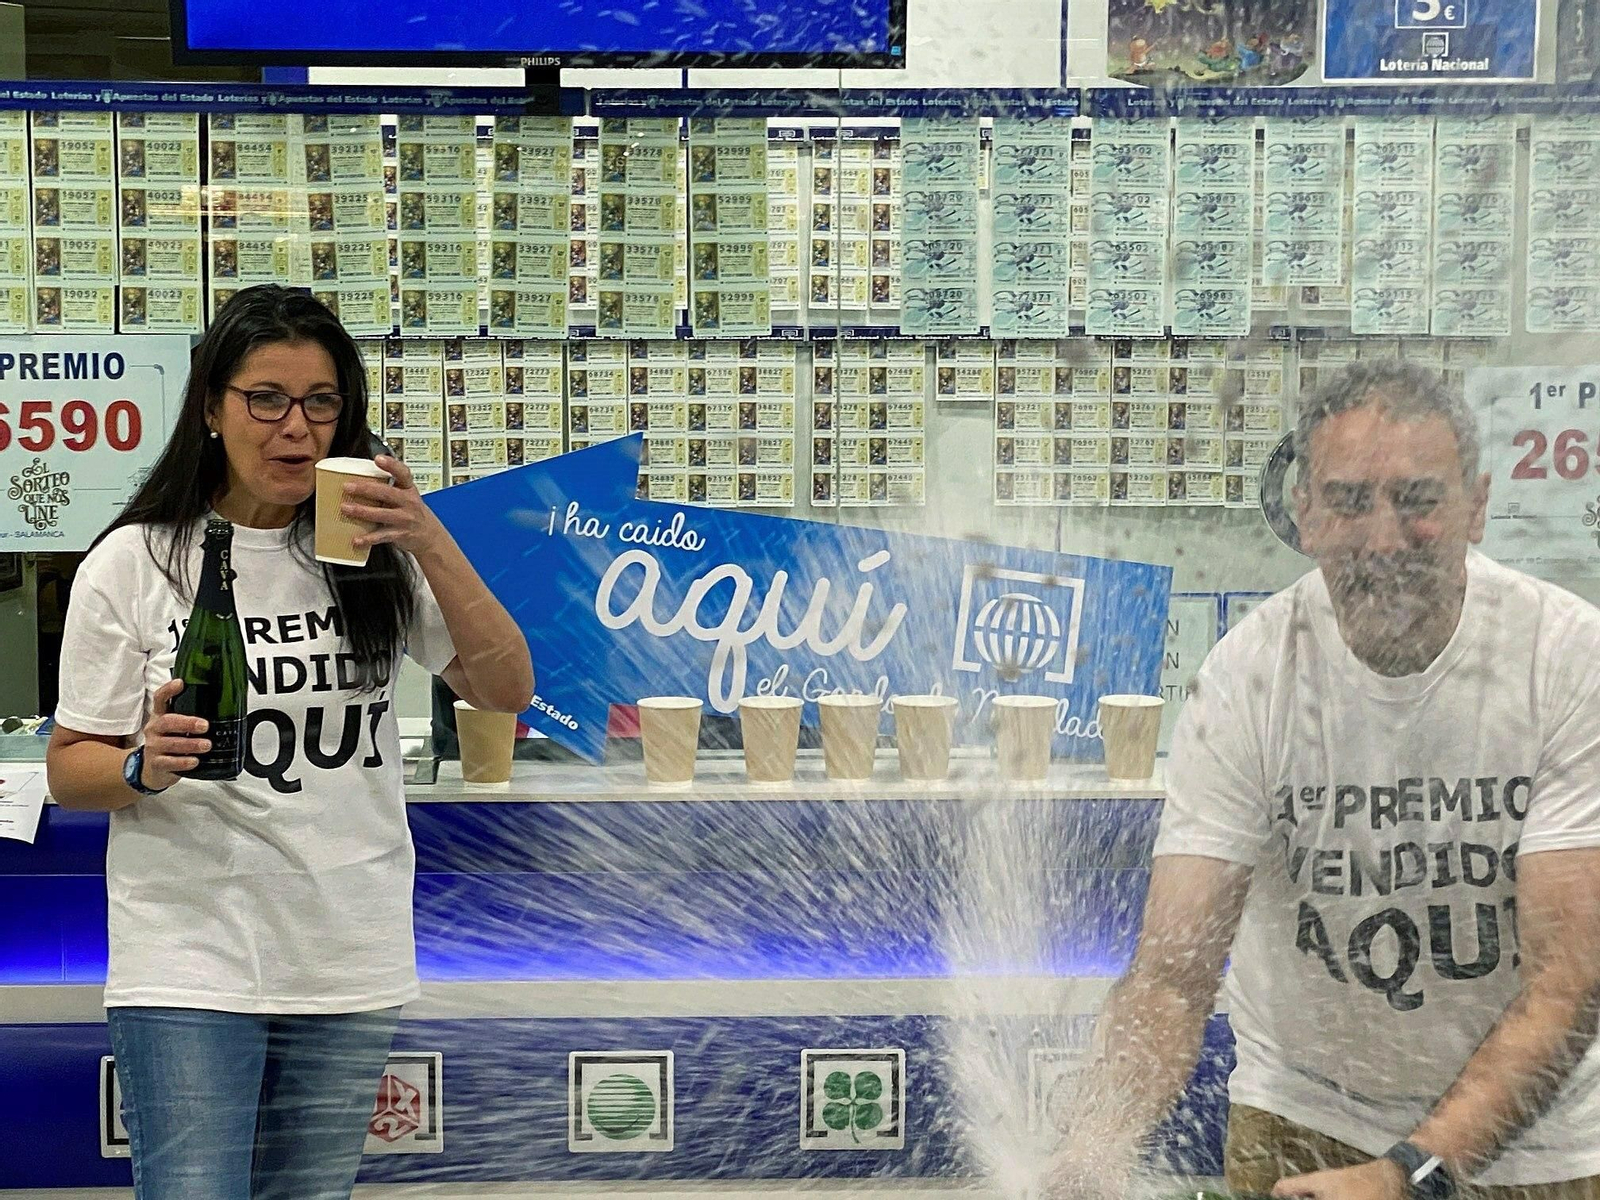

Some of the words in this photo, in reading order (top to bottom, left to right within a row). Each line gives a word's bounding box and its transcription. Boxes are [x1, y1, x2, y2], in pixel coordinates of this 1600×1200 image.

[520, 57, 561, 66] PHILIPS
[1432, 58, 1489, 71] Nacional
[12, 90, 47, 99] Estado
[52, 91, 92, 100] Loterías
[112, 92, 159, 102] Apuestas
[162, 93, 177, 101] del
[180, 94, 214, 102] Estado
[326, 95, 342, 103] del
[344, 96, 378, 104] Estado
[0, 352, 125, 380] PREMIO
[1530, 382, 1566, 410] 1er
[1511, 429, 1600, 480] 26
[8, 472, 70, 500] SORTEO
[24, 493, 45, 504] QUE
[220, 550, 229, 591] CAVA
[244, 606, 344, 644] REM
[595, 549, 908, 714] aquí
[757, 664, 789, 697] el
[530, 694, 579, 730] Estado
[245, 690, 390, 794] QUÍ
[1274, 784, 1327, 827] 1er
[1334, 776, 1532, 830] PREMIO
